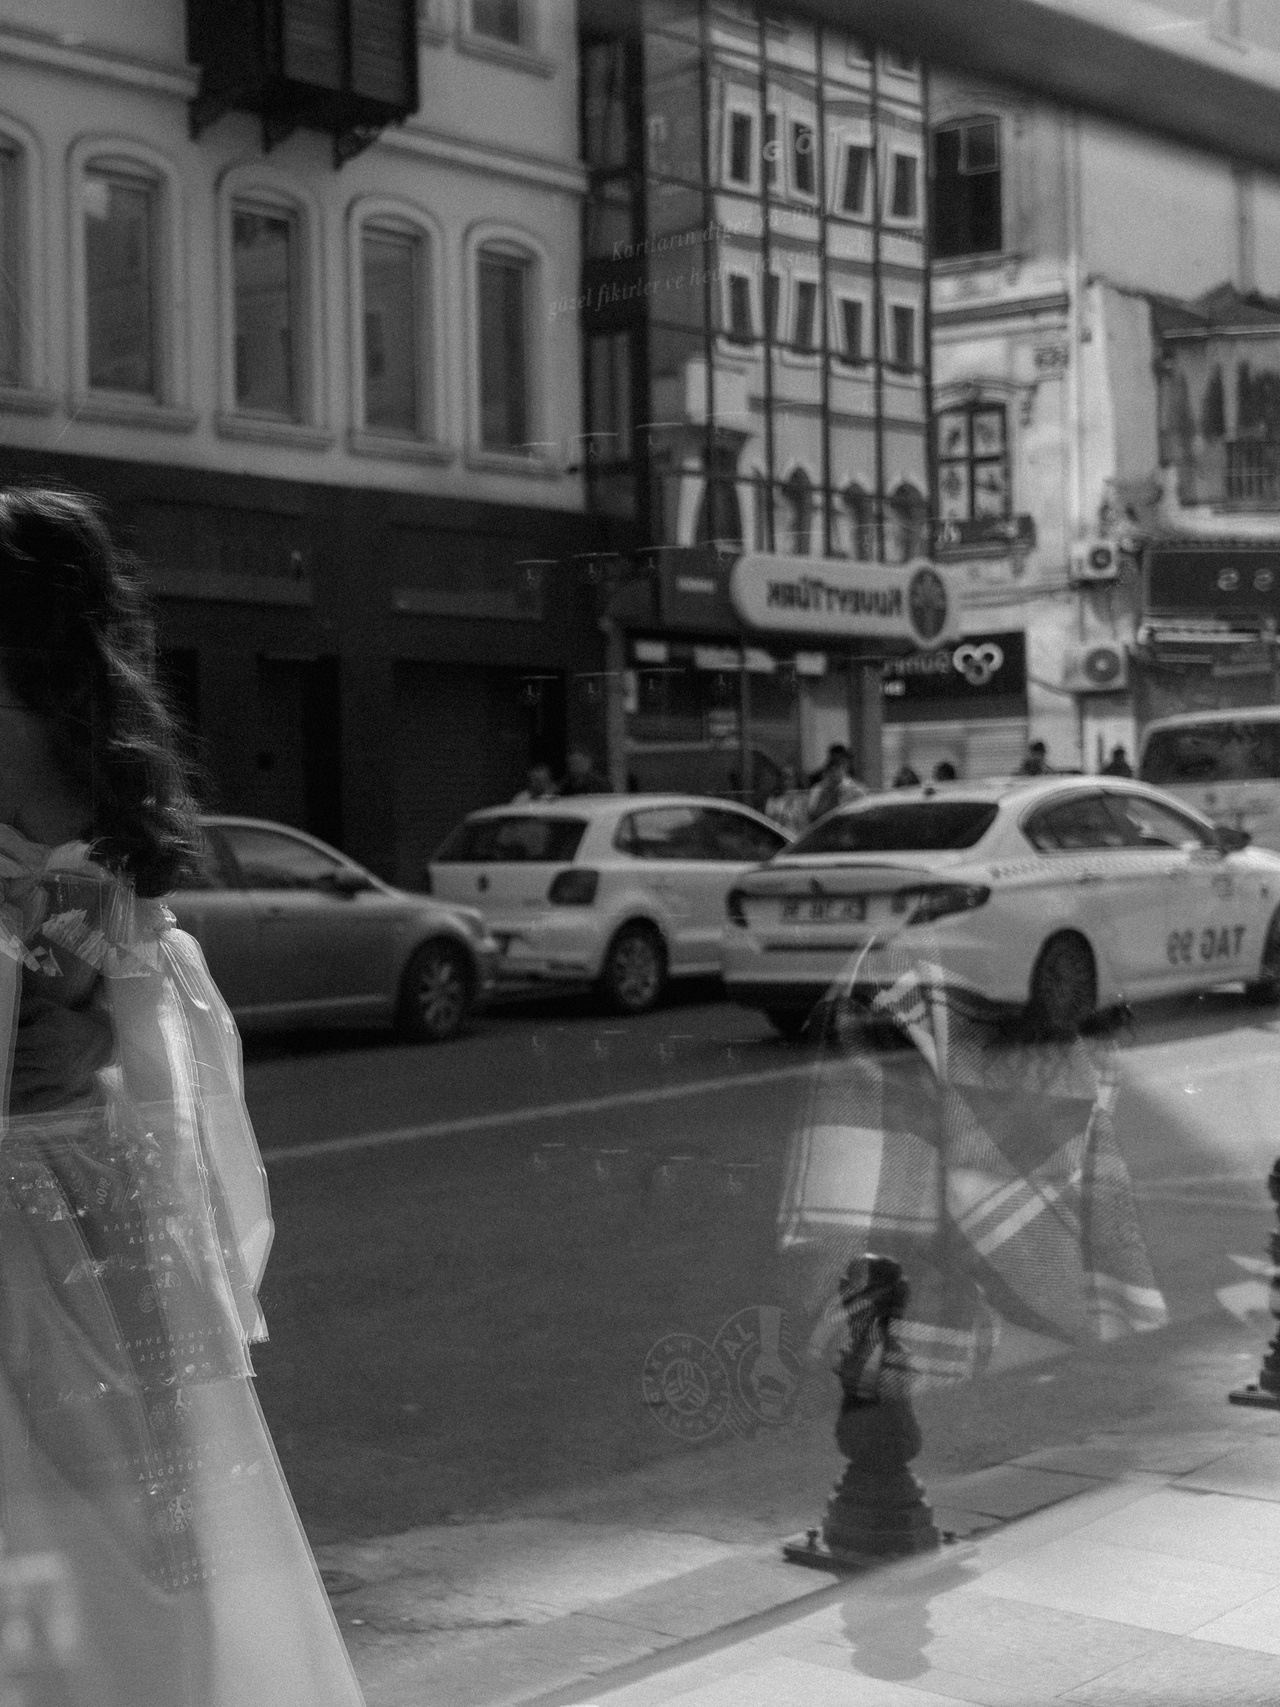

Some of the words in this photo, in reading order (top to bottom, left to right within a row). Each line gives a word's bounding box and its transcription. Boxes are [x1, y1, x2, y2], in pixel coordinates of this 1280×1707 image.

[103, 1219, 151, 1233] KAHVE
[114, 1335, 162, 1351] KAHVE
[139, 1343, 205, 1363] ALGÖTÜR
[138, 1459, 204, 1482] ALGÖTÜR
